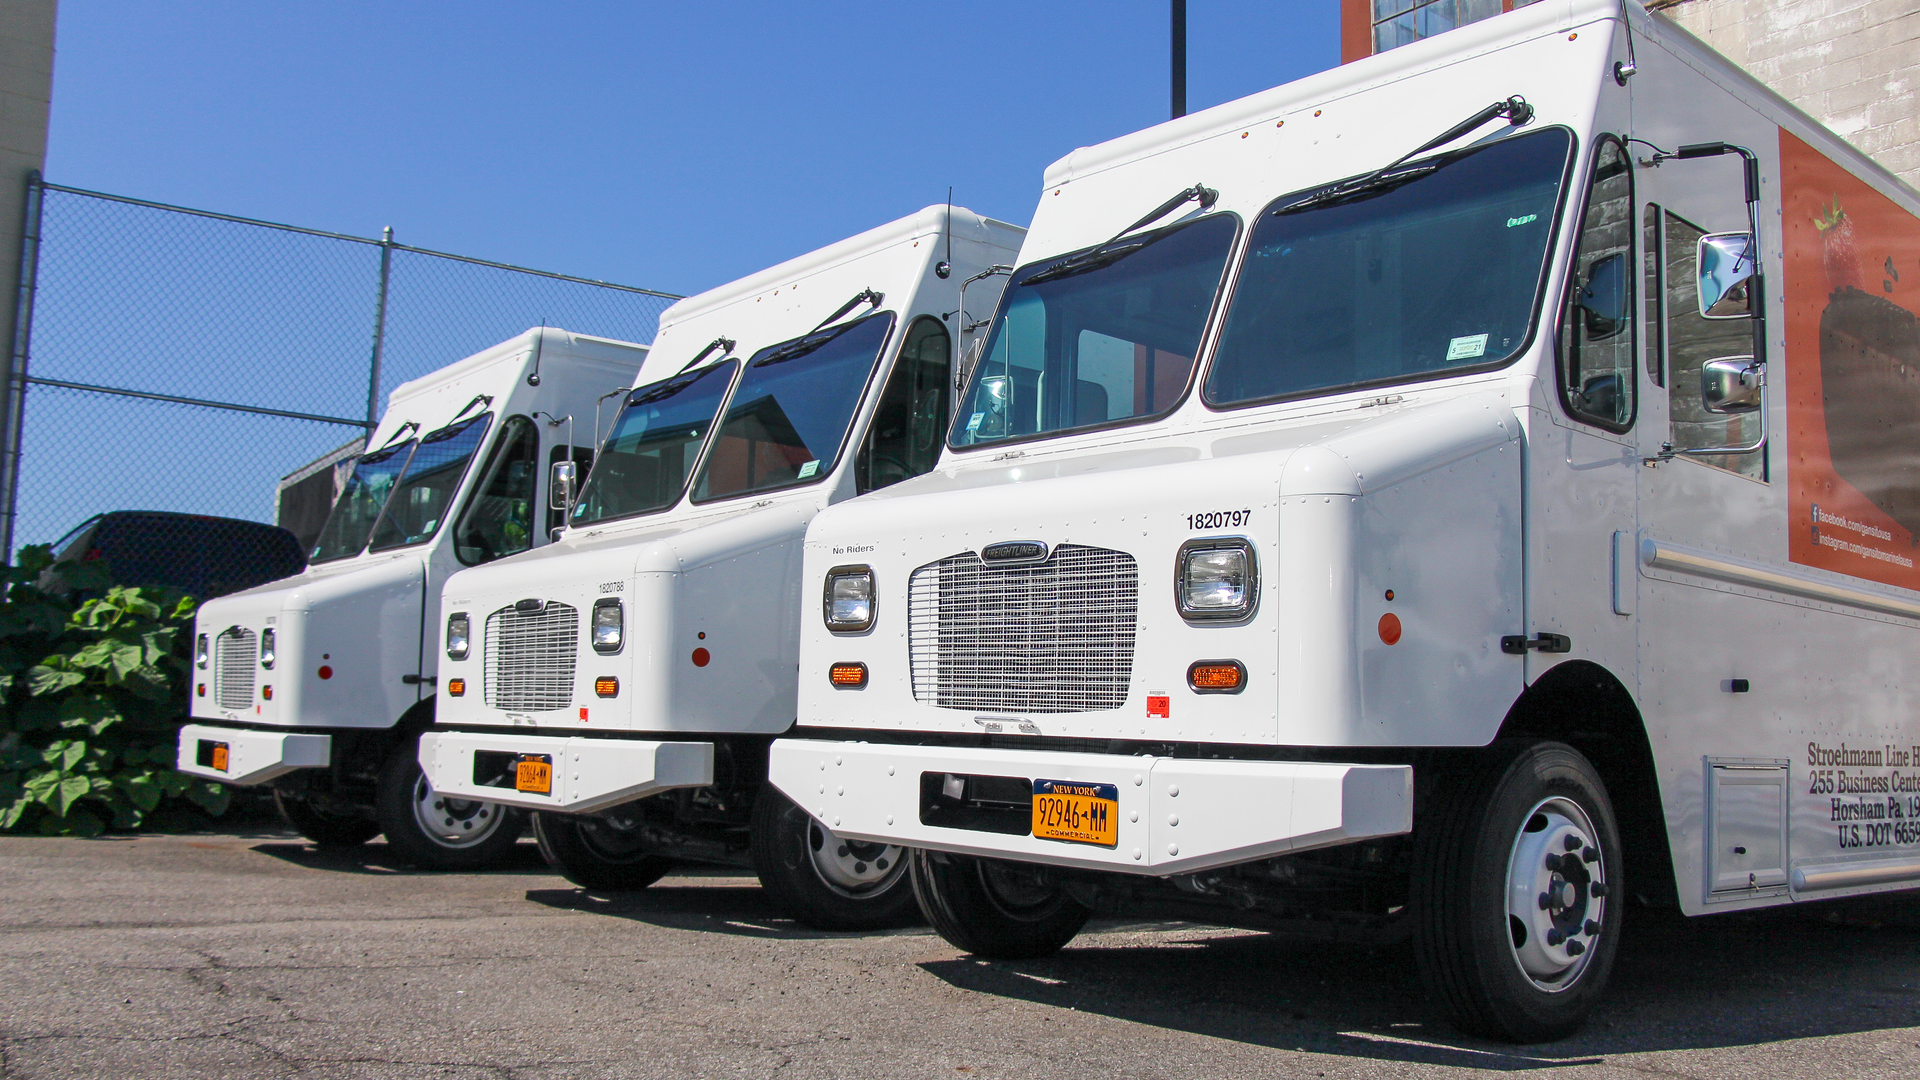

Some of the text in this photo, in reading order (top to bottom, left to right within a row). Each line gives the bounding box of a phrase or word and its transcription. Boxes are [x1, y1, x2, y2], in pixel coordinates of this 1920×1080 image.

[1187, 510, 1251, 530] 1820797
[832, 545, 875, 555] No Riders
[986, 545, 1038, 558] FREIGHTLINER
[599, 581, 624, 593] 1820788
[1807, 741, 1883, 767] Stroehmann
[1885, 744, 1910, 767] Line
[1809, 769, 1835, 795] 255
[1837, 769, 1889, 794] Business
[1053, 785, 1096, 797] NEW YORK
[1830, 795, 1920, 821] Horsham Pa. 19
[1050, 829, 1095, 840] COMMERCIAL
[1838, 824, 1863, 849] U.S.
[1866, 822, 1892, 847] DOT
